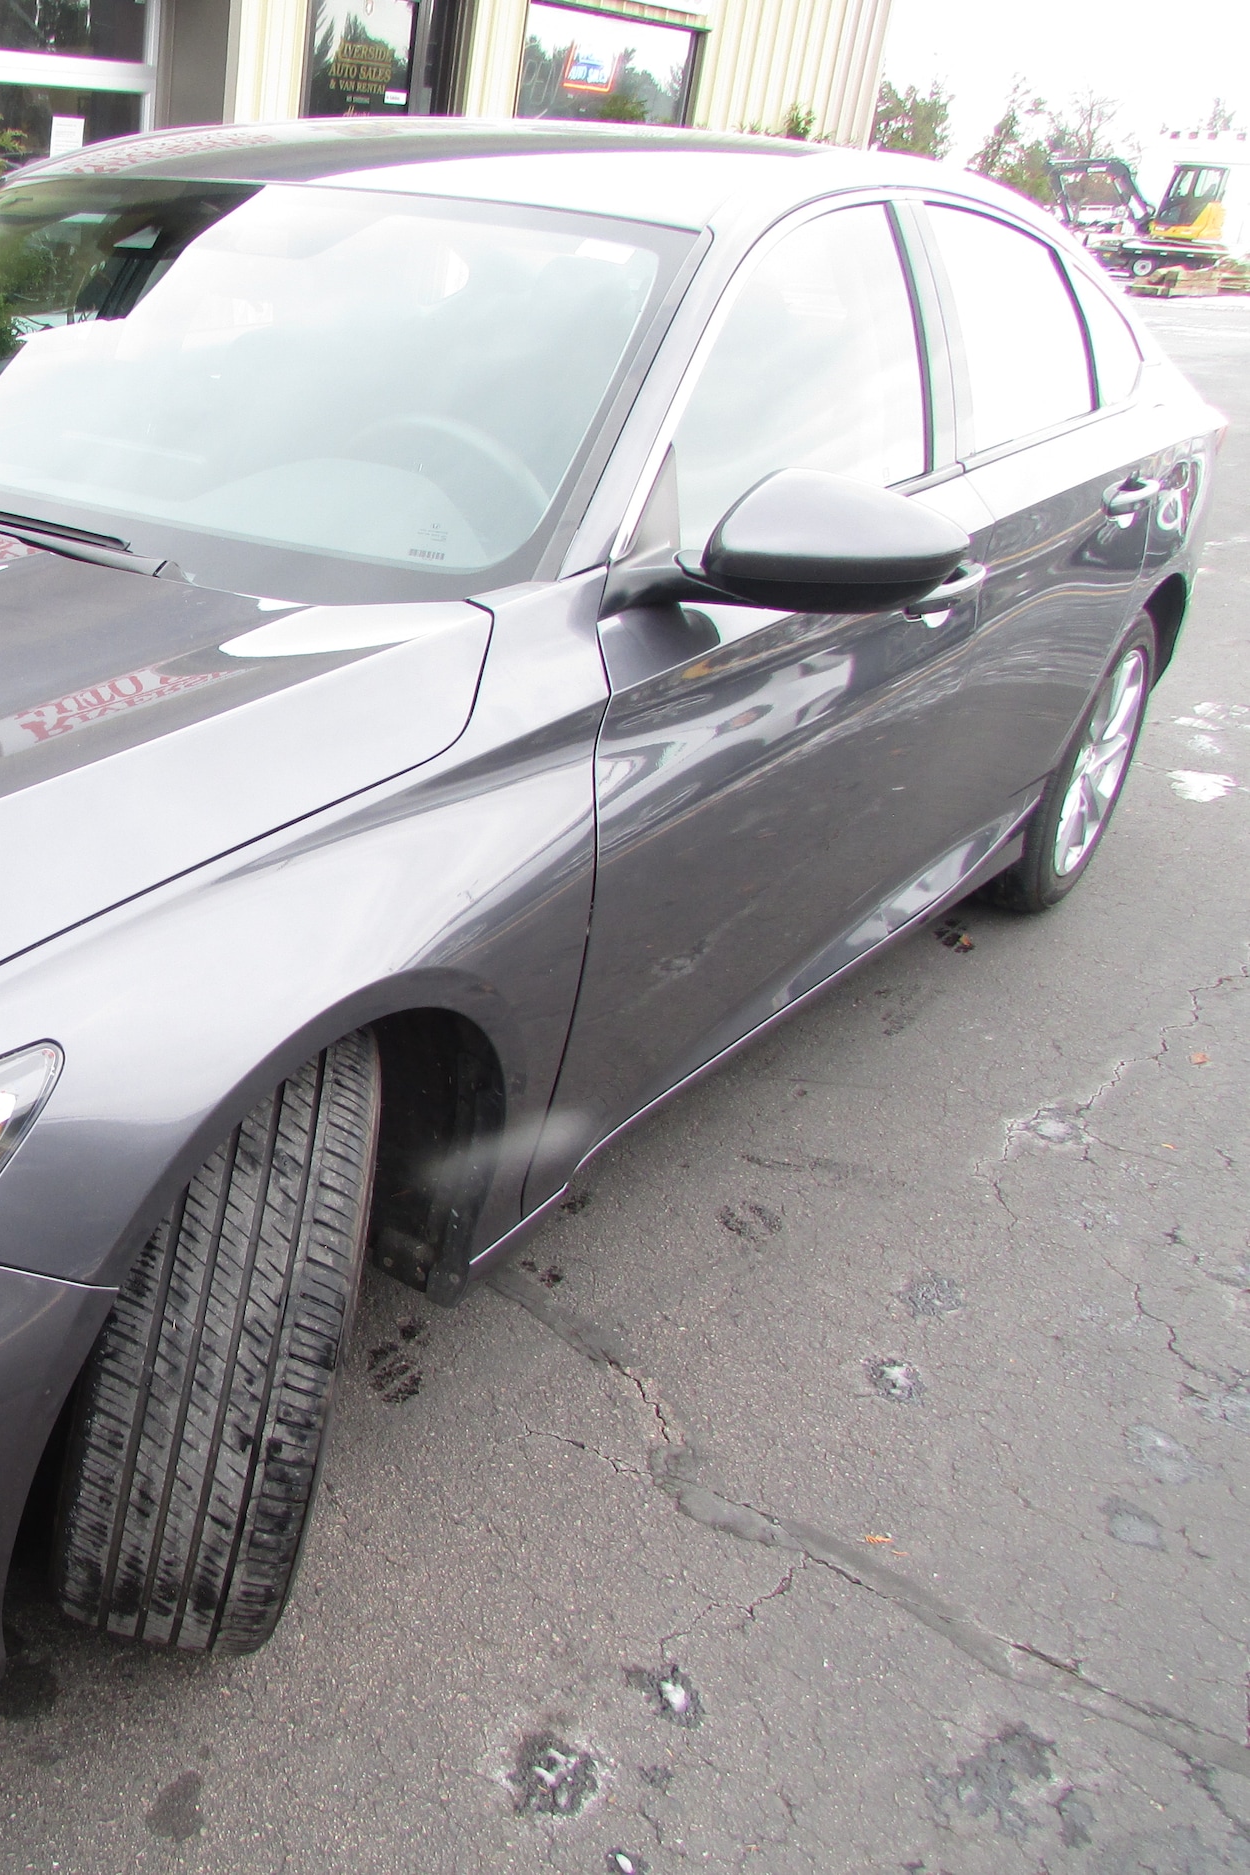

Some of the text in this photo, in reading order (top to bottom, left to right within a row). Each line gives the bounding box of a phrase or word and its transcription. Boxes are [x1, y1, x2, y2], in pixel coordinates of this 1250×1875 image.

[328, 62, 392, 83] AUTO SALES
[339, 79, 355, 93] VAN
